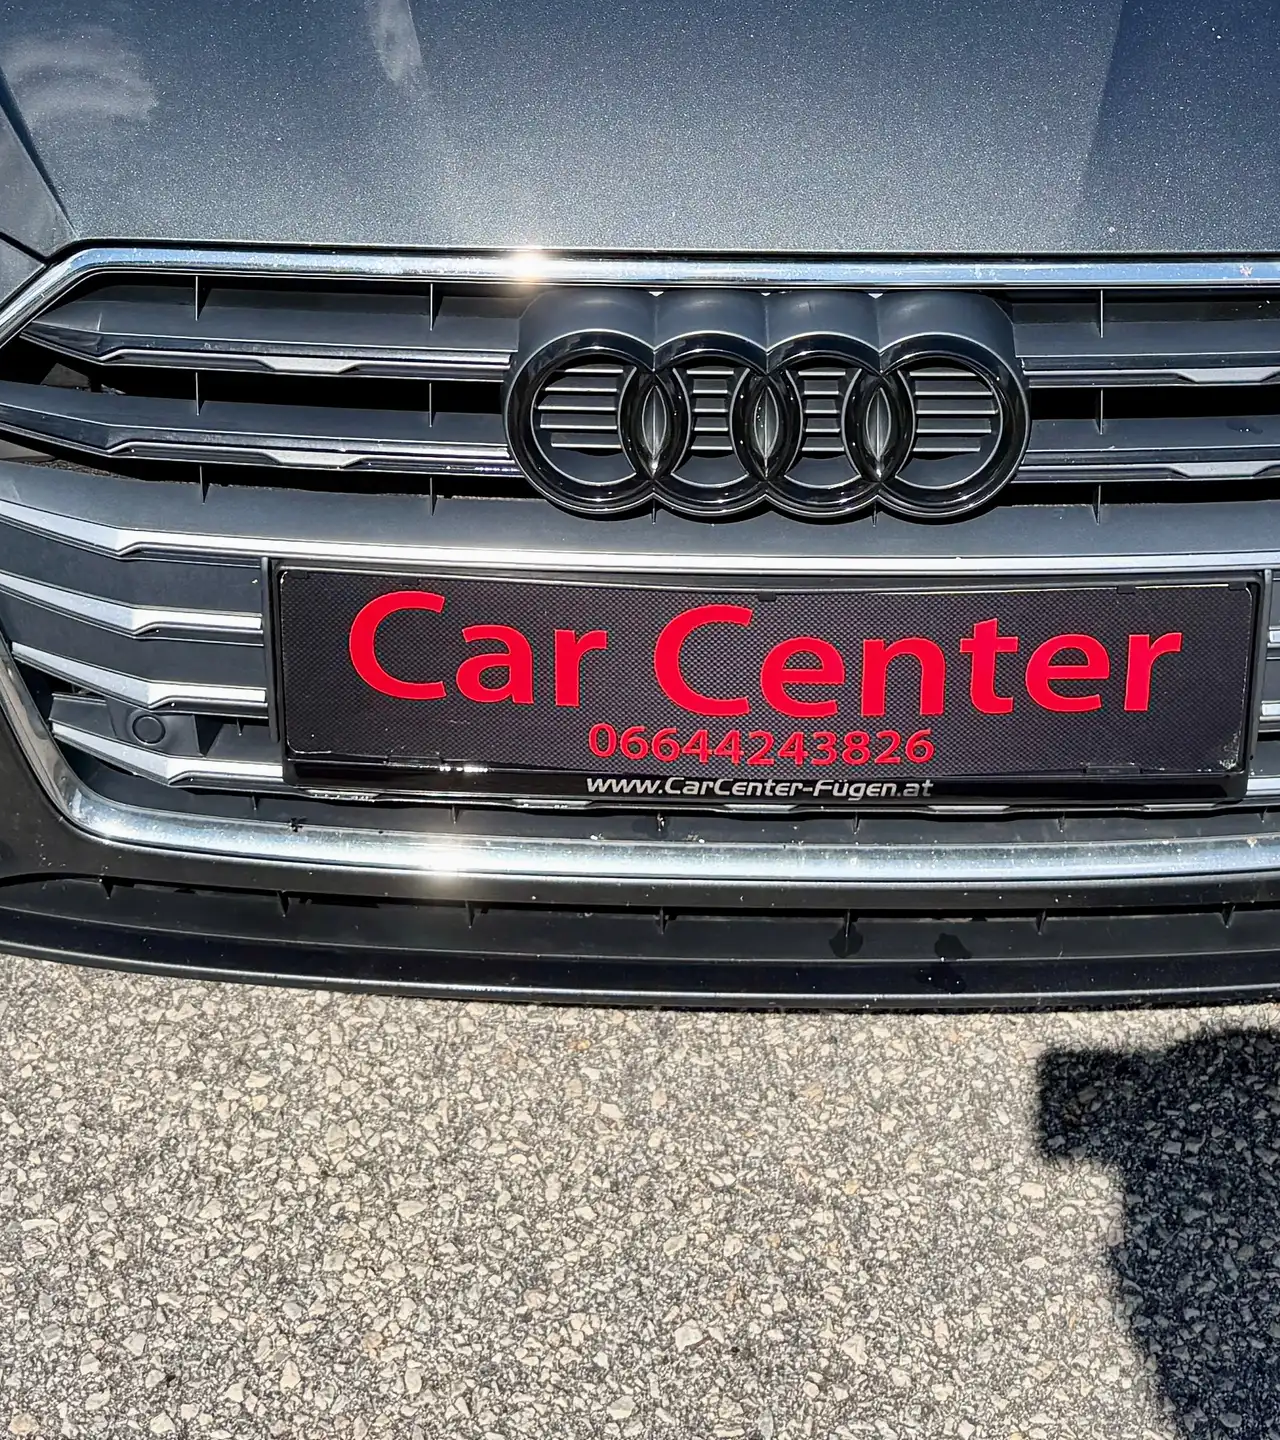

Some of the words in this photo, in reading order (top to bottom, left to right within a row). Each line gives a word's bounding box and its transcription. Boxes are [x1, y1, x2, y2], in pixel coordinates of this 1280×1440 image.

[349, 590, 609, 708] Car
[653, 604, 1183, 719] Center
[588, 722, 935, 766] 06644243826
[586, 777, 934, 800] www.CarCenter-Fügen.at
